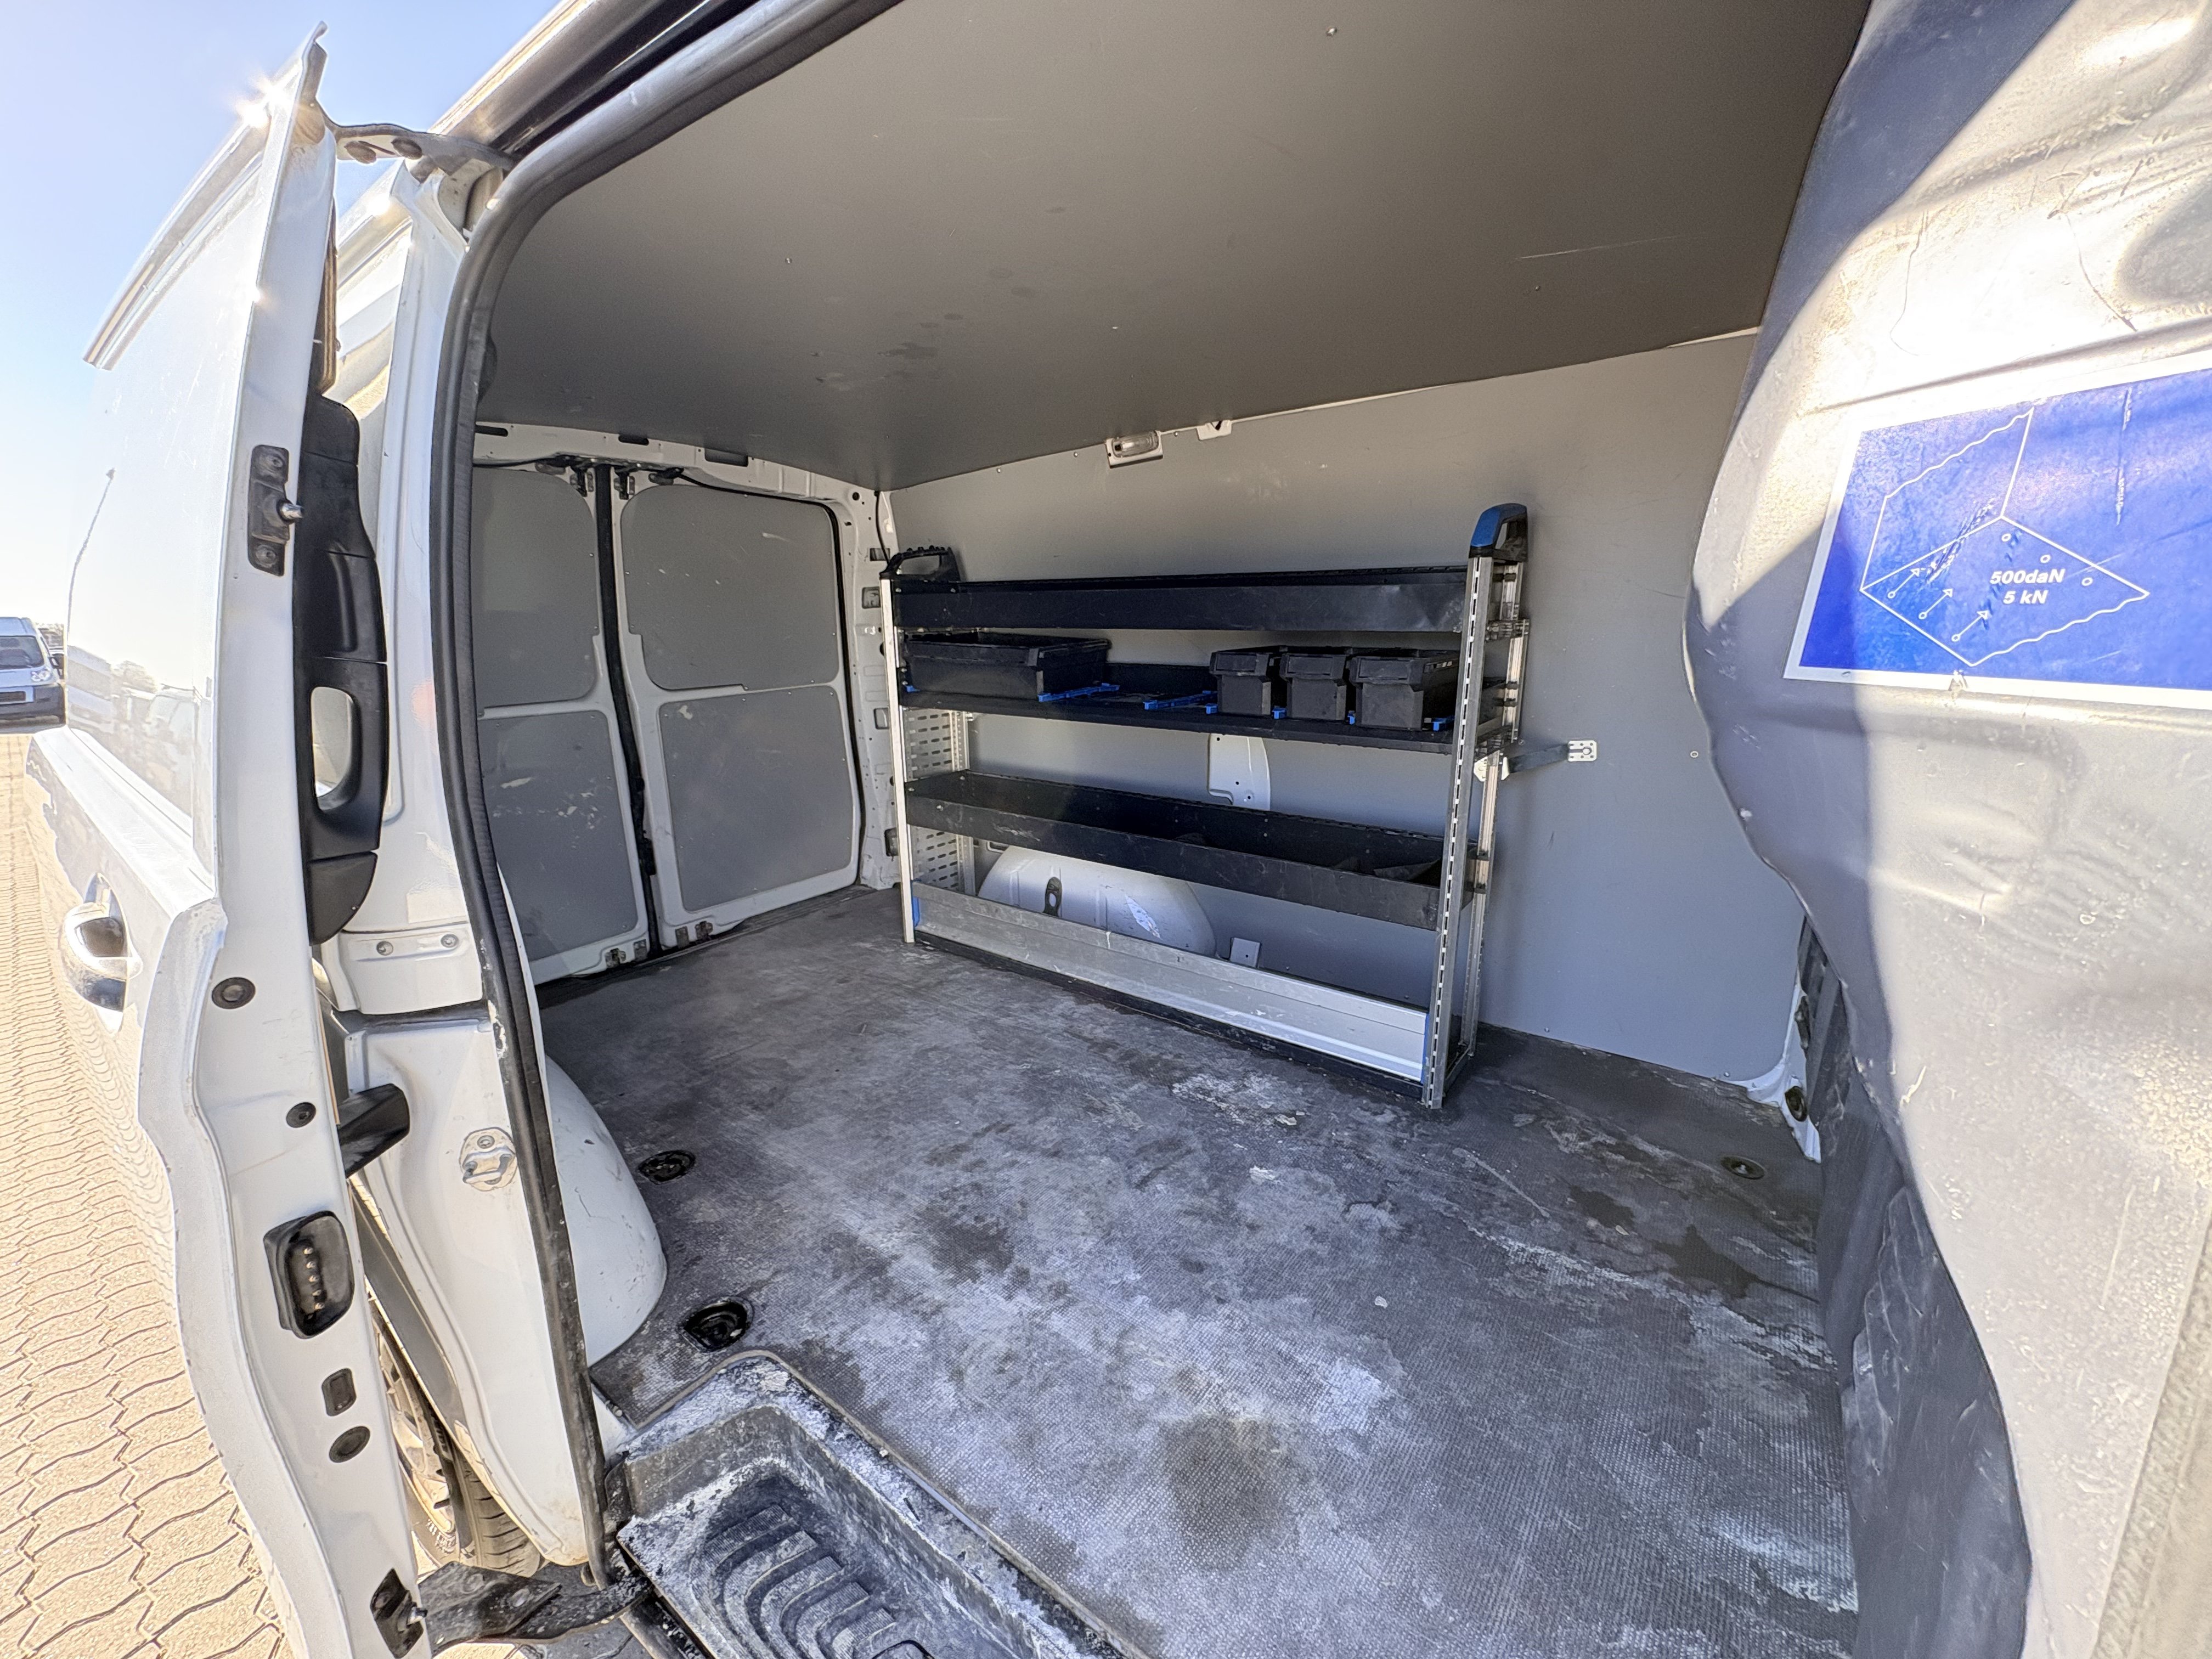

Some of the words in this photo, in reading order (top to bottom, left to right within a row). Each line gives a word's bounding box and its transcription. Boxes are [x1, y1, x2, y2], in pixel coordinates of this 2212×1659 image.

[1990, 569, 2066, 584] 500daN
[2003, 590, 2016, 604] 5
[2020, 590, 2049, 604] kN
